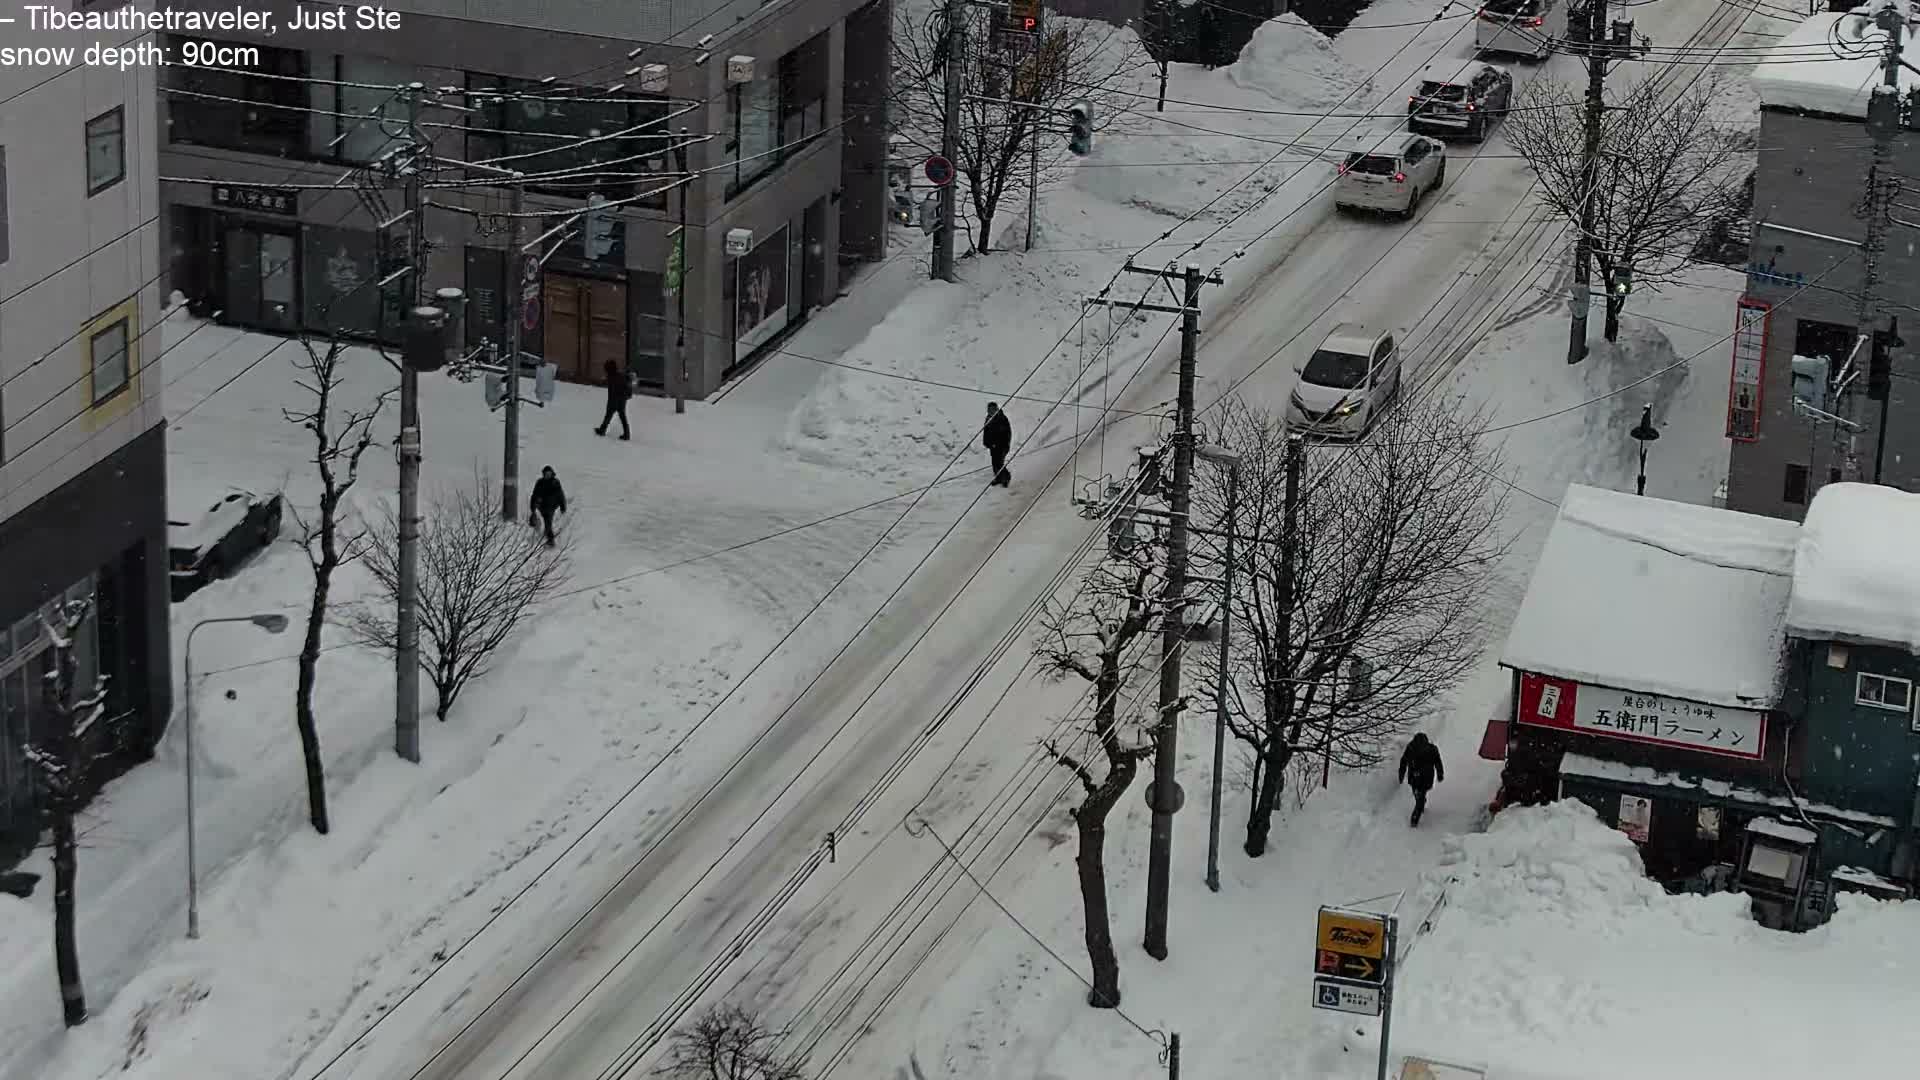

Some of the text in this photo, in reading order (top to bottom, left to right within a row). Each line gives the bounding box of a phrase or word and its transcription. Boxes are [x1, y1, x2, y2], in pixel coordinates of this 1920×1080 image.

[1622, 695, 1716, 721] 屋台のしょうゆ味
[1592, 709, 1745, 745] 五衛門ラーメン
